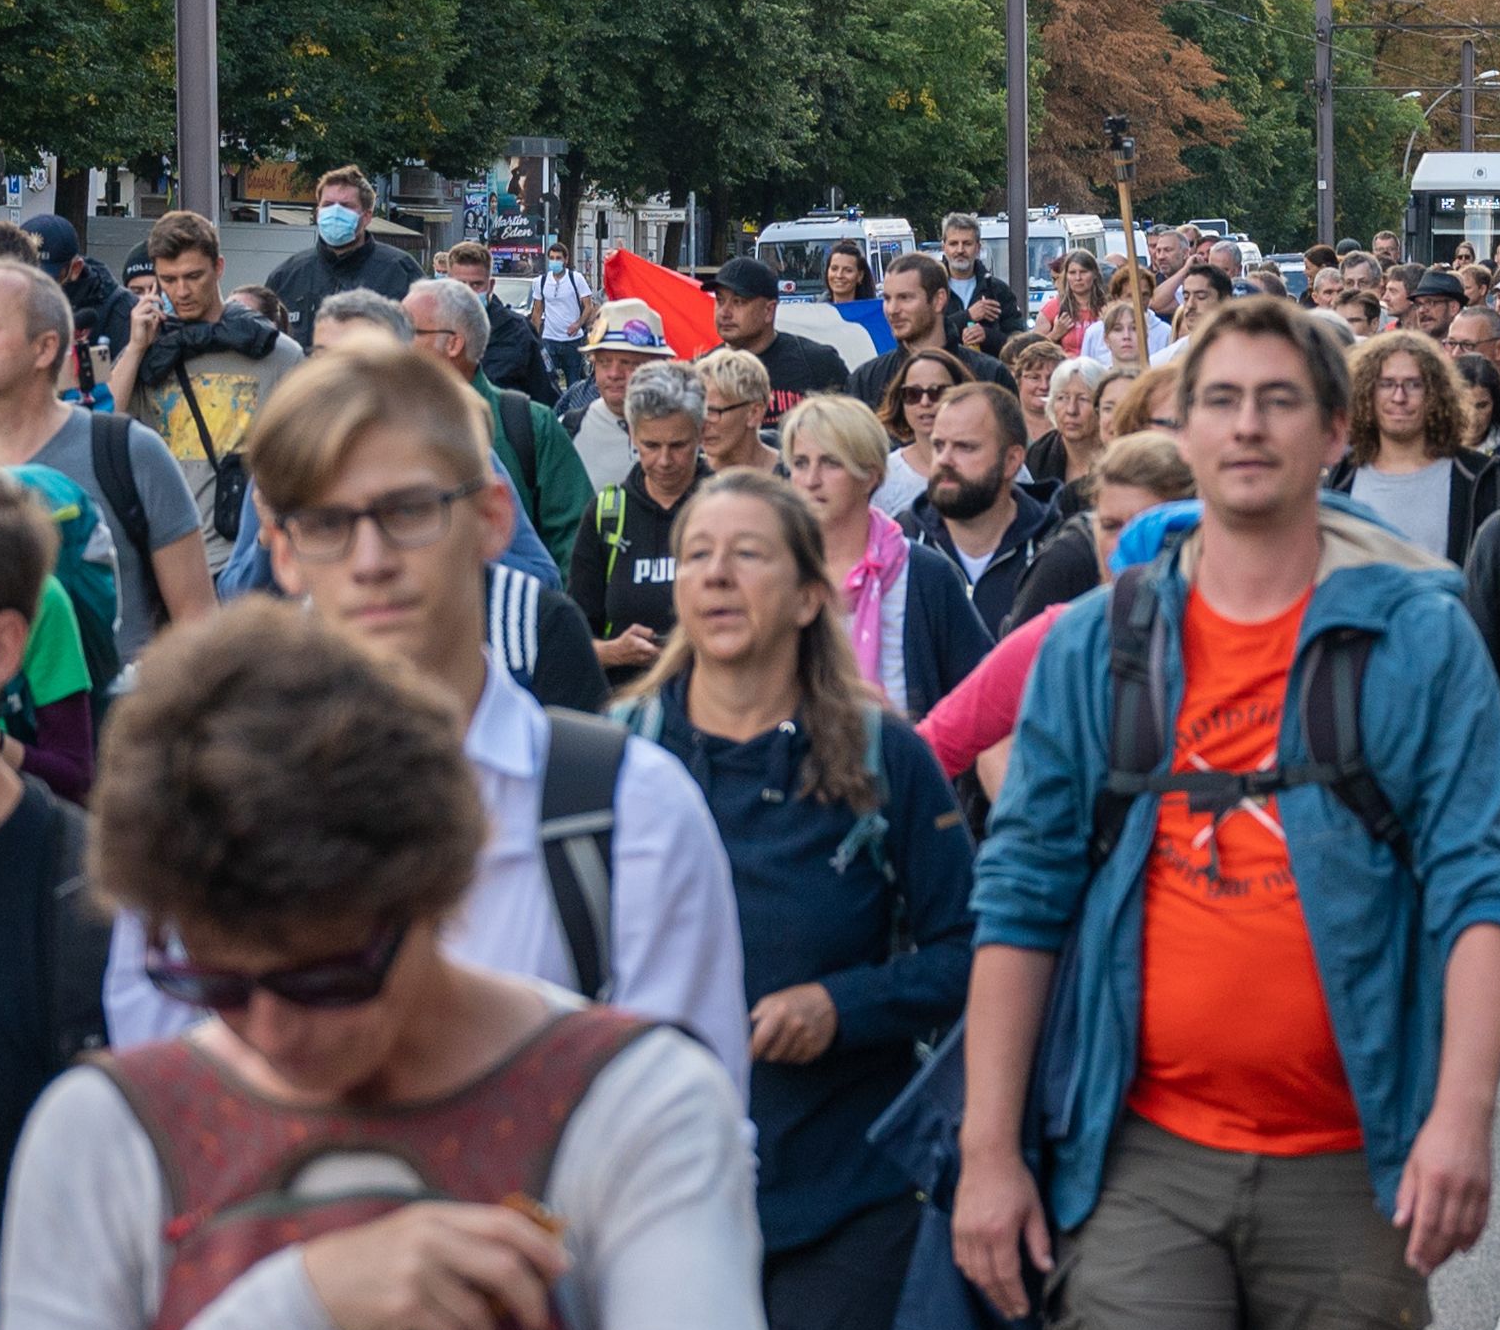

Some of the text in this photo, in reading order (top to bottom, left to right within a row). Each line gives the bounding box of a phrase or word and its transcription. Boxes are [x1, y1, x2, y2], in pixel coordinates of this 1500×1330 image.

[492, 215, 530, 229] Martin
[501, 227, 534, 240] Eden
[126, 262, 154, 274] POLIZ
[633, 557, 676, 584] PU
